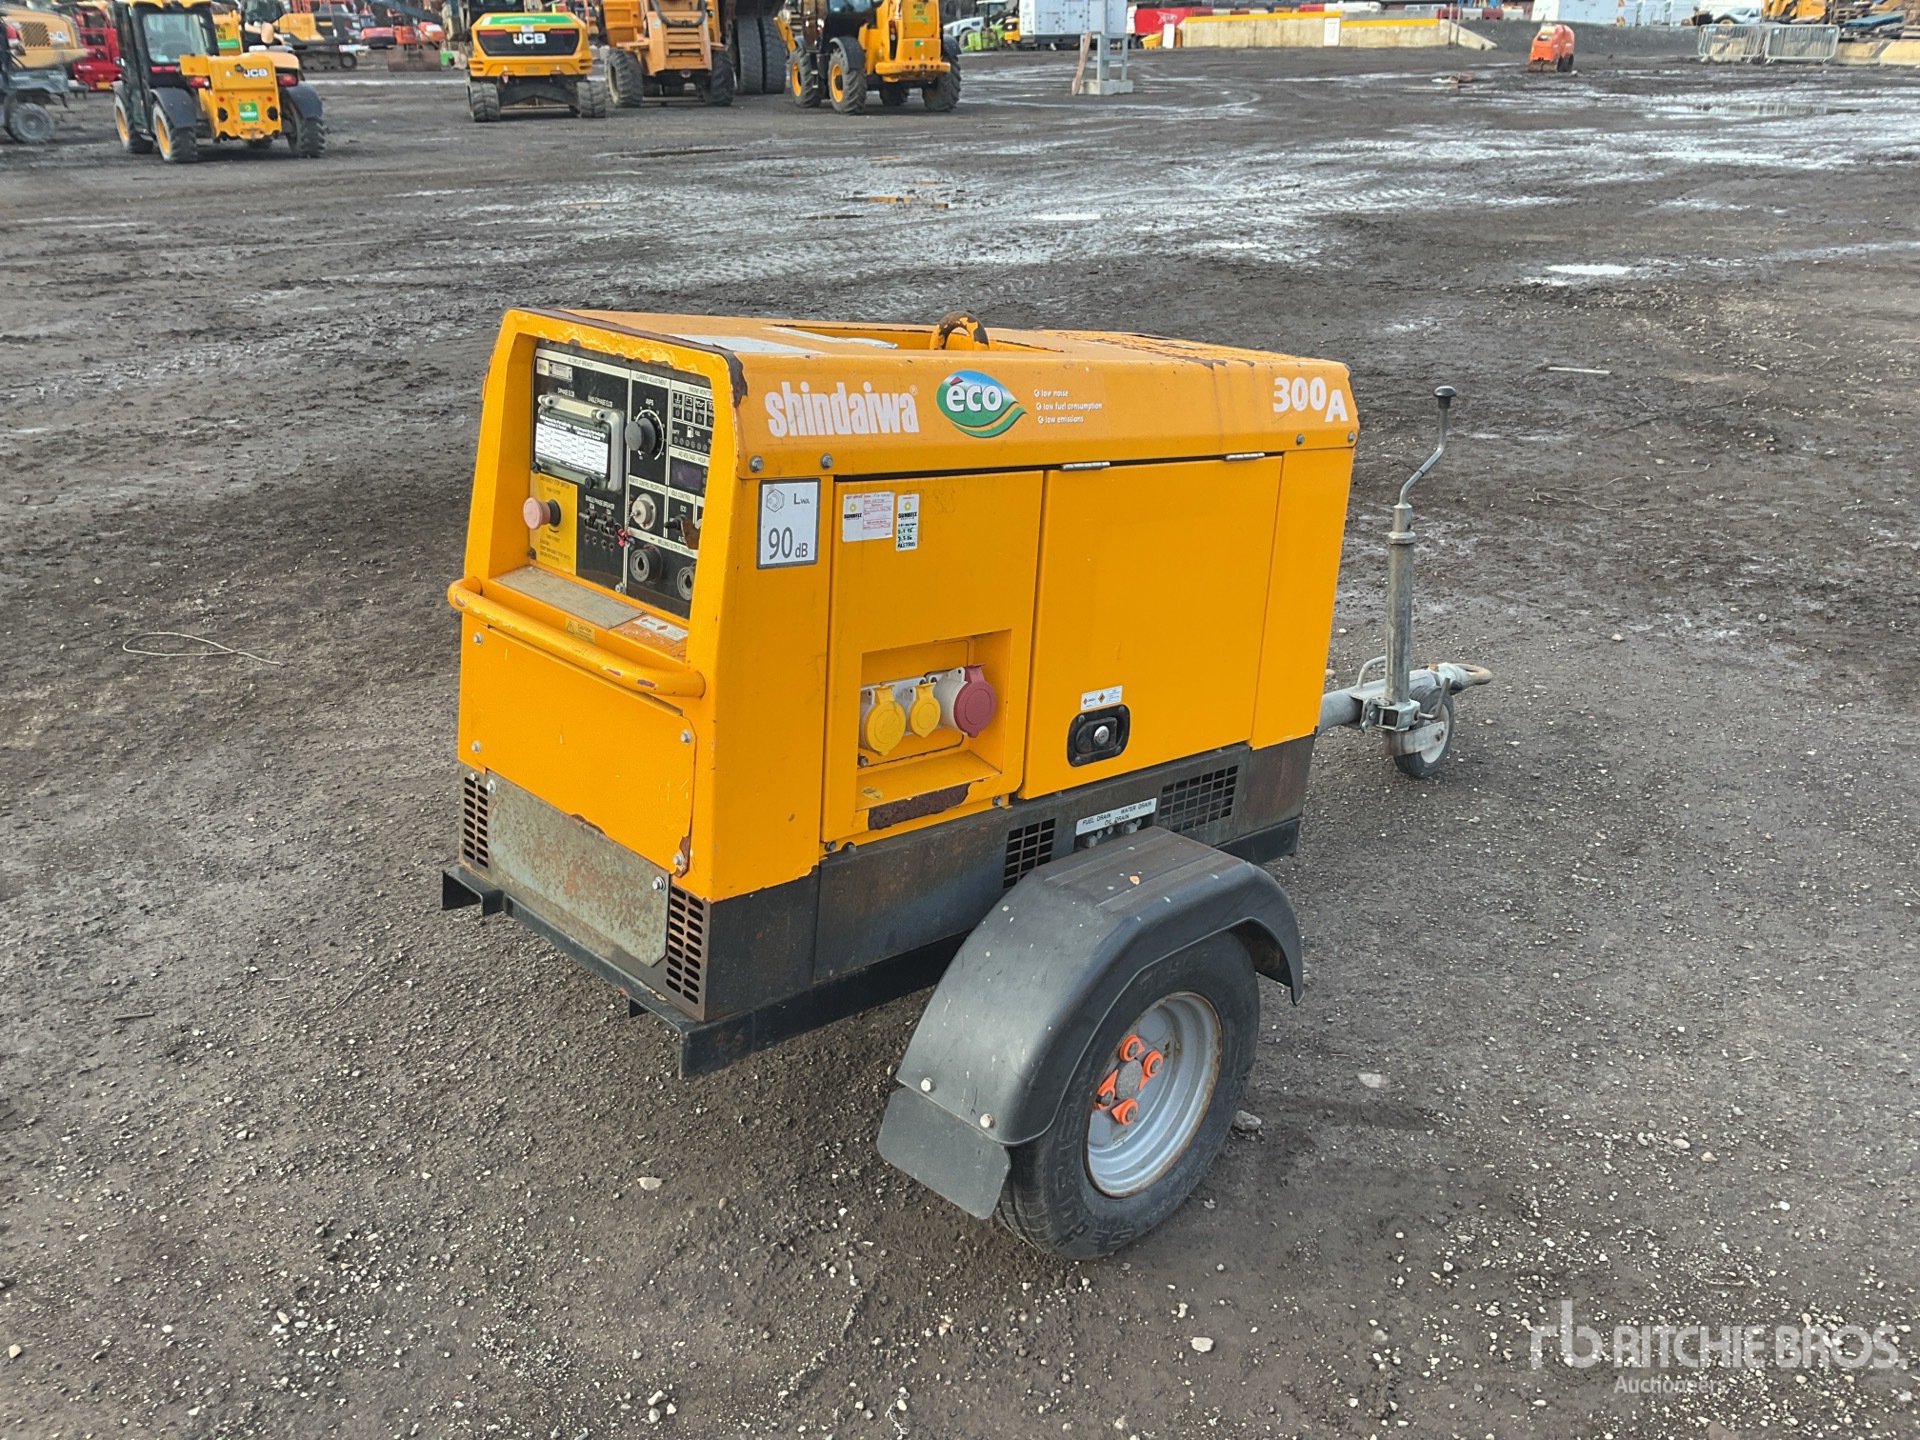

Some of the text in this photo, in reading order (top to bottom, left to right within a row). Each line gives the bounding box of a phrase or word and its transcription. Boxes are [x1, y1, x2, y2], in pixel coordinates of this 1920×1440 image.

[513, 33, 546, 44] JCB
[244, 68, 268, 78] JCB
[1042, 389, 1052, 397] low
[1272, 376, 1349, 422] 300A
[765, 381, 920, 437] shindaiwa
[1055, 402, 1066, 410] fuel
[1068, 402, 1102, 411] consumption
[1057, 415, 1084, 423] emissions
[769, 527, 808, 560] 90 dB
[1120, 801, 1152, 814] WATER DRAIN
[1082, 813, 1111, 825] FUEL DRAIN
[1114, 814, 1130, 823] DRAIN
